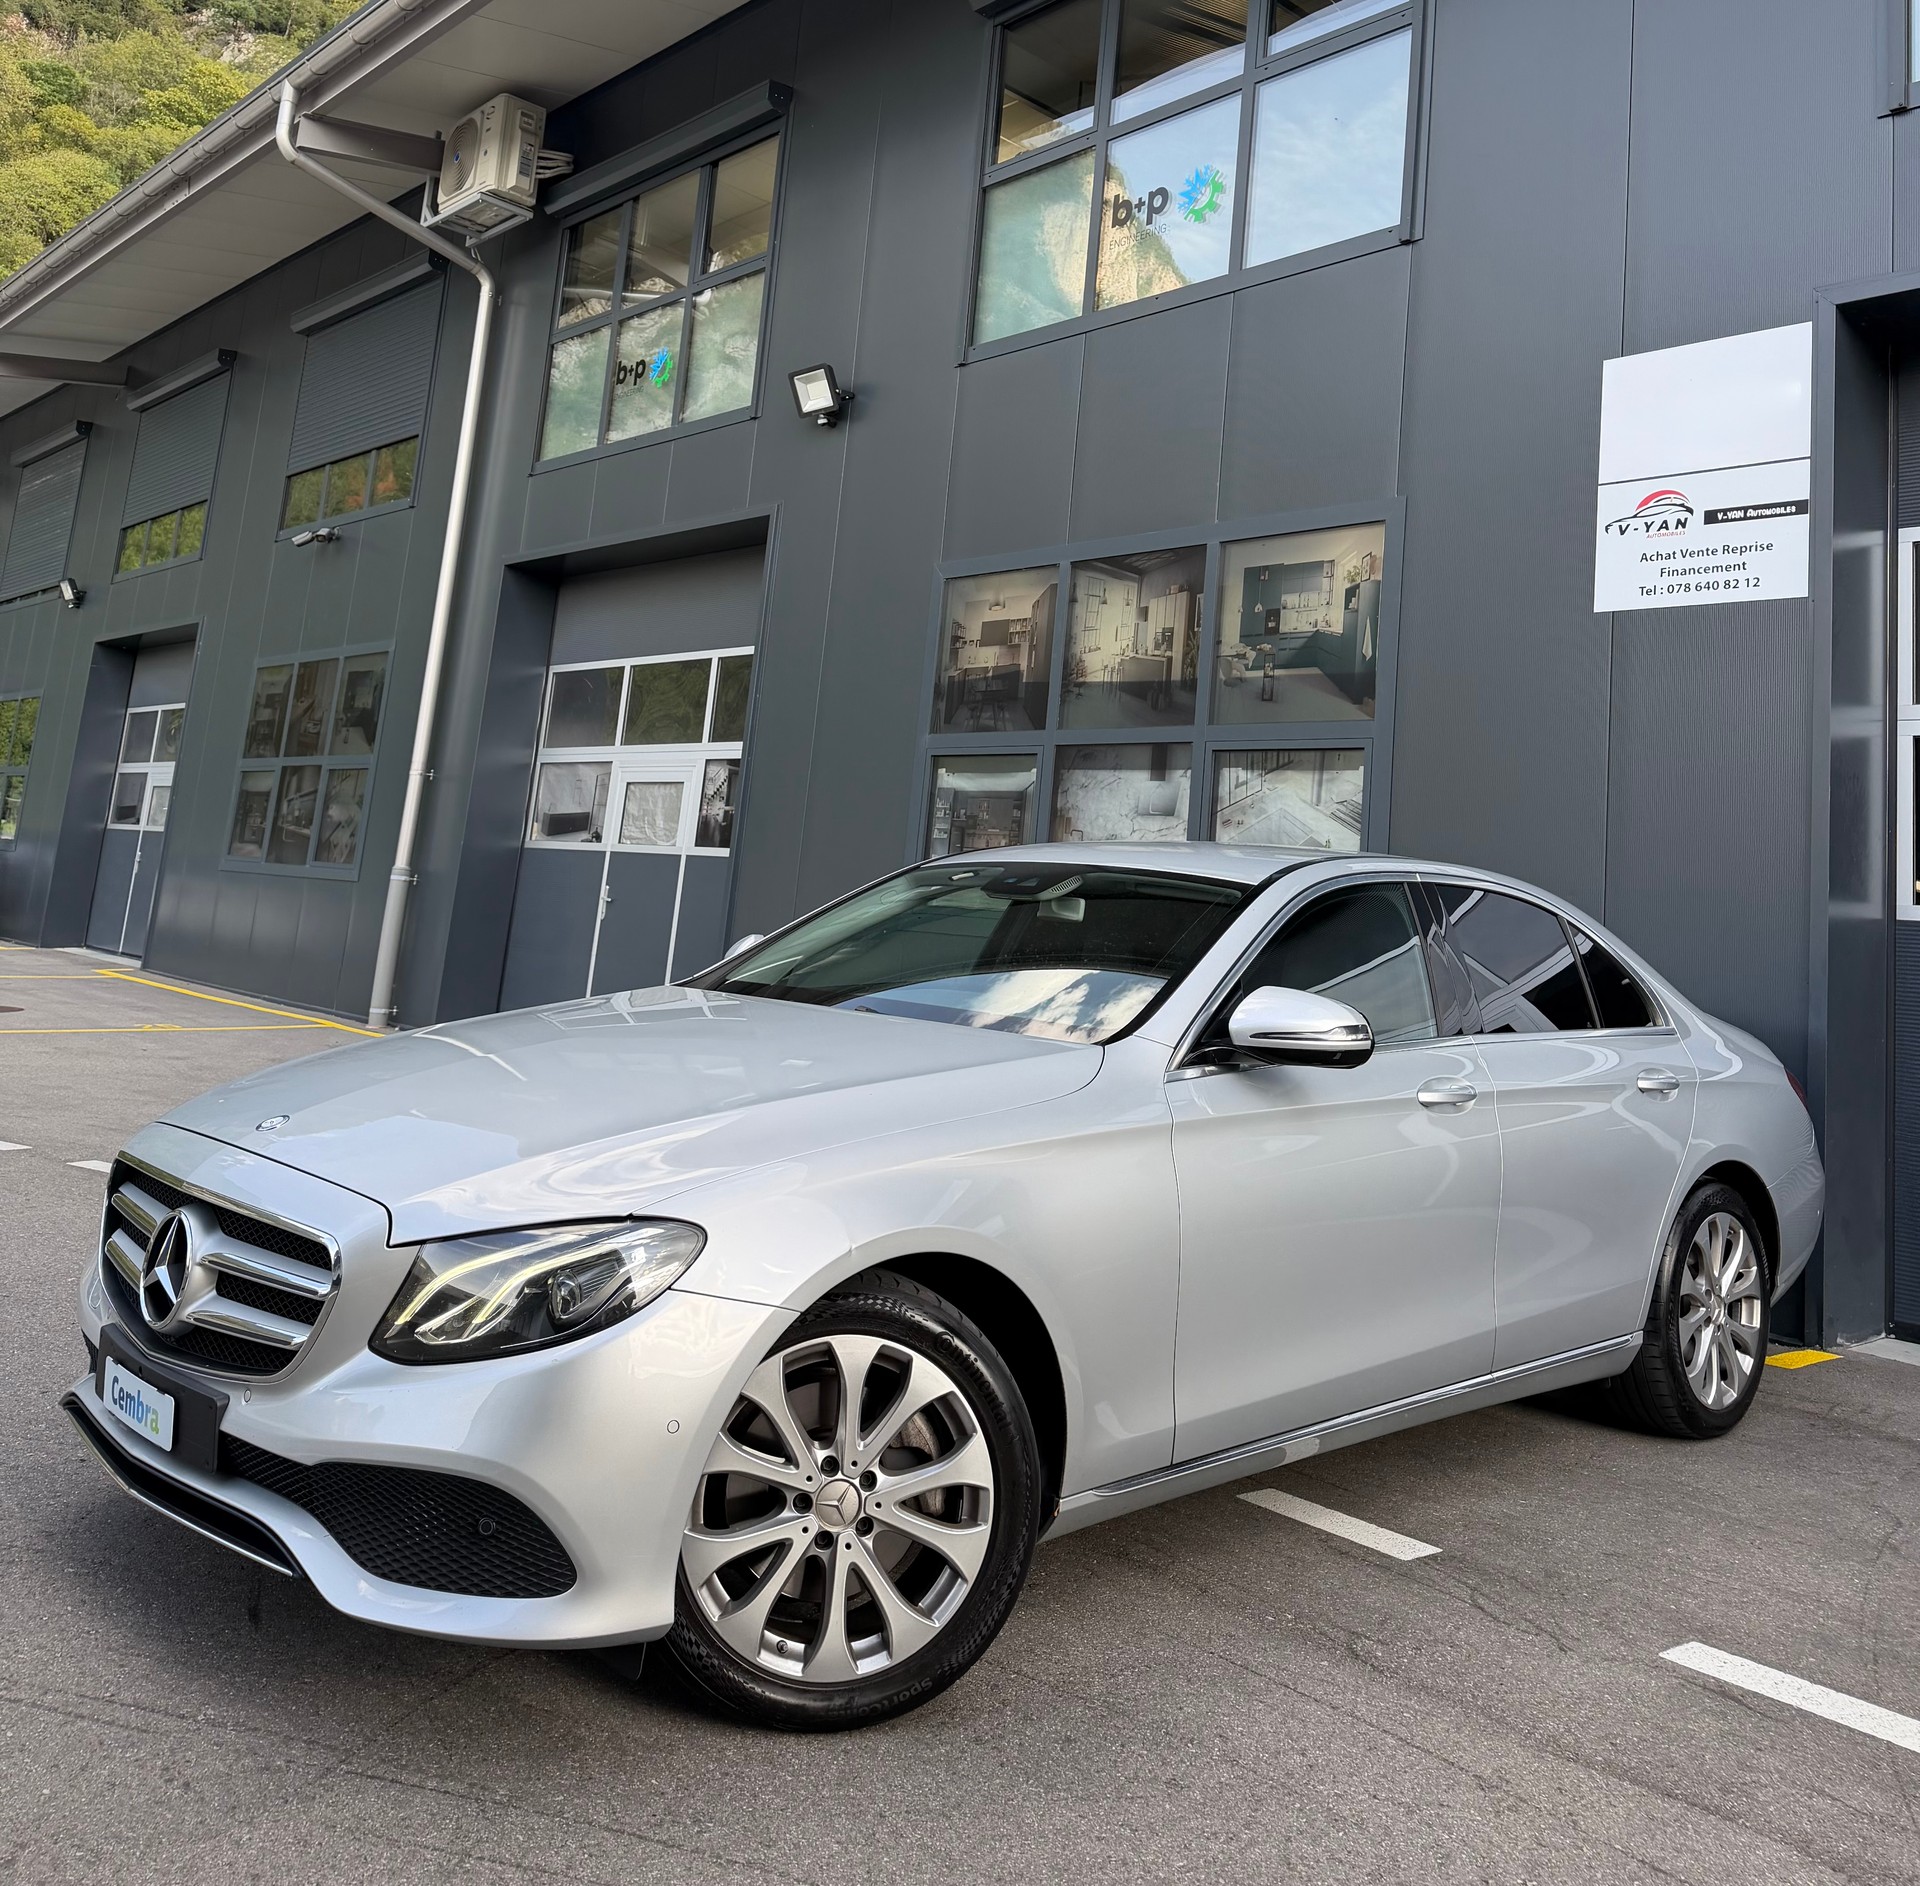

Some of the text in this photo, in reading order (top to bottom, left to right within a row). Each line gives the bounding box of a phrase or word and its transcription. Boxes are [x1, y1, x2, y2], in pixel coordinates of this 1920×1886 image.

[1111, 186, 1169, 228] b+p
[1109, 223, 1168, 250] ENGINEERING
[616, 359, 646, 386] b+p
[1717, 509, 1745, 521] V-YAN
[1618, 517, 1689, 536] V-YAN
[1646, 530, 1687, 539] AUTOMOBILES
[1640, 541, 1774, 563] Achat Vente Reprise
[1660, 561, 1748, 578] Financement
[1667, 583, 1692, 595] 078
[1695, 580, 1720, 592] 640
[1723, 578, 1740, 590] 82
[1744, 577, 1761, 588] 12
[935, 1331, 1011, 1430] Continental
[111, 1375, 160, 1435] Cembra
